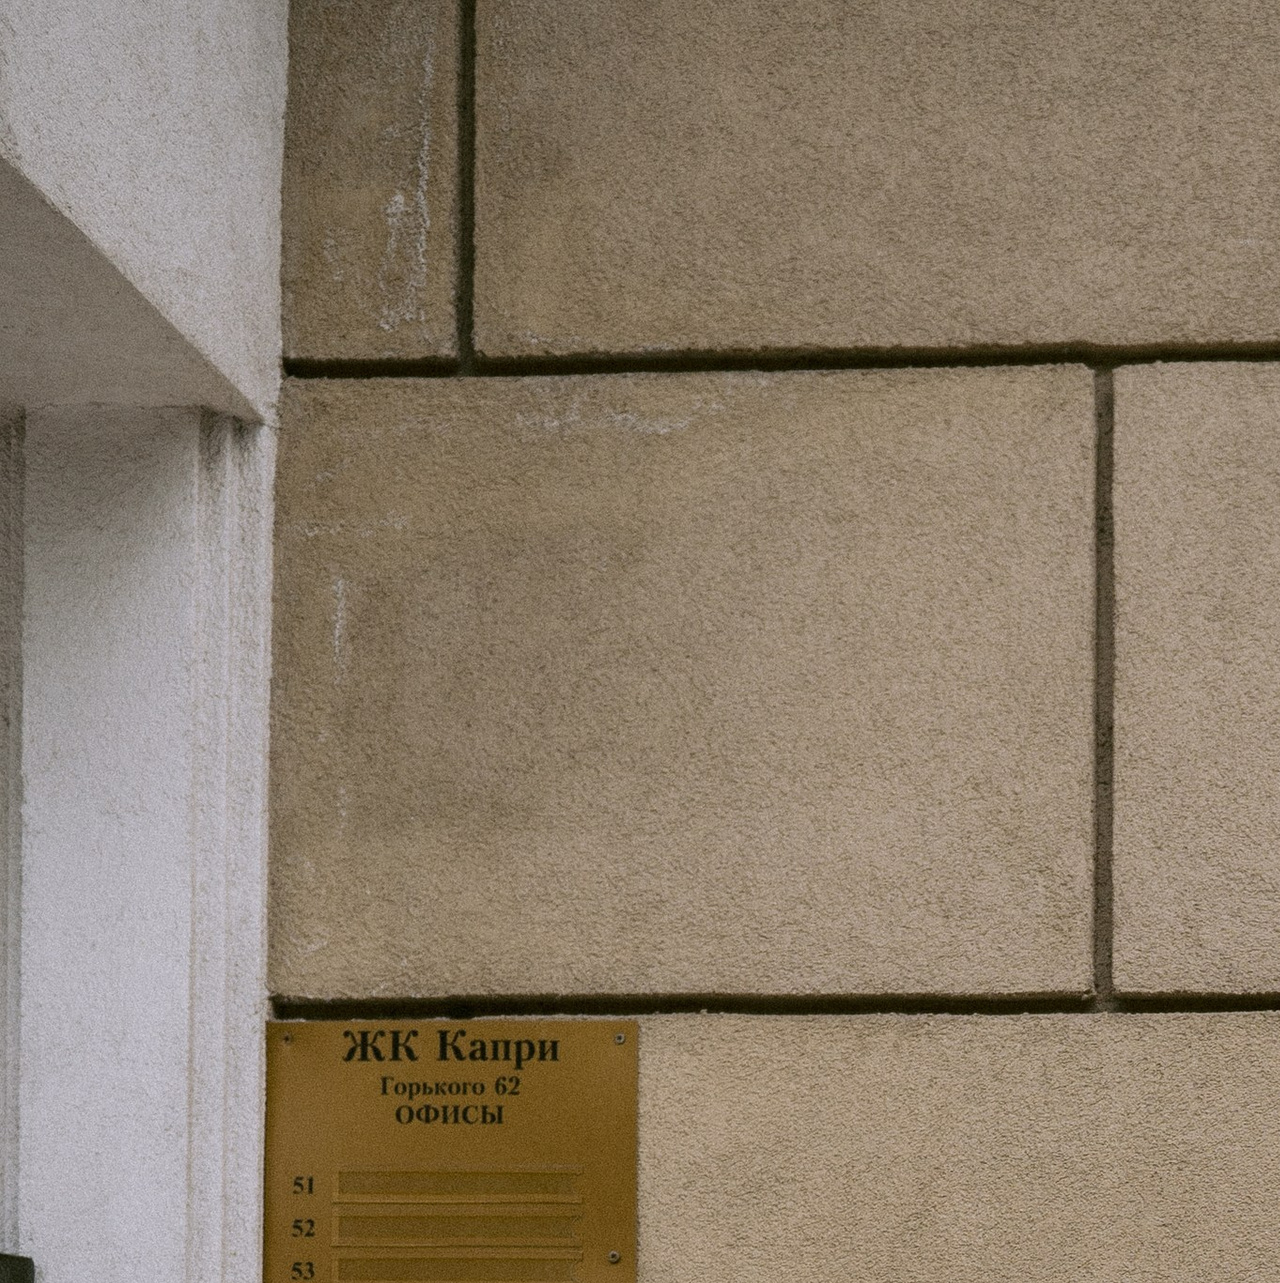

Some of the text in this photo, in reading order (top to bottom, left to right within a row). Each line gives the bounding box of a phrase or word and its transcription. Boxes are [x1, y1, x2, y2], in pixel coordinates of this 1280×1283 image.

[343, 1030, 560, 1070] ЖК Капри
[381, 1076, 522, 1101] Горького 62
[395, 1104, 505, 1125] ОФИСЫ
[293, 1176, 316, 1196] 51
[292, 1219, 317, 1239] 52
[291, 1262, 316, 1282] 53
